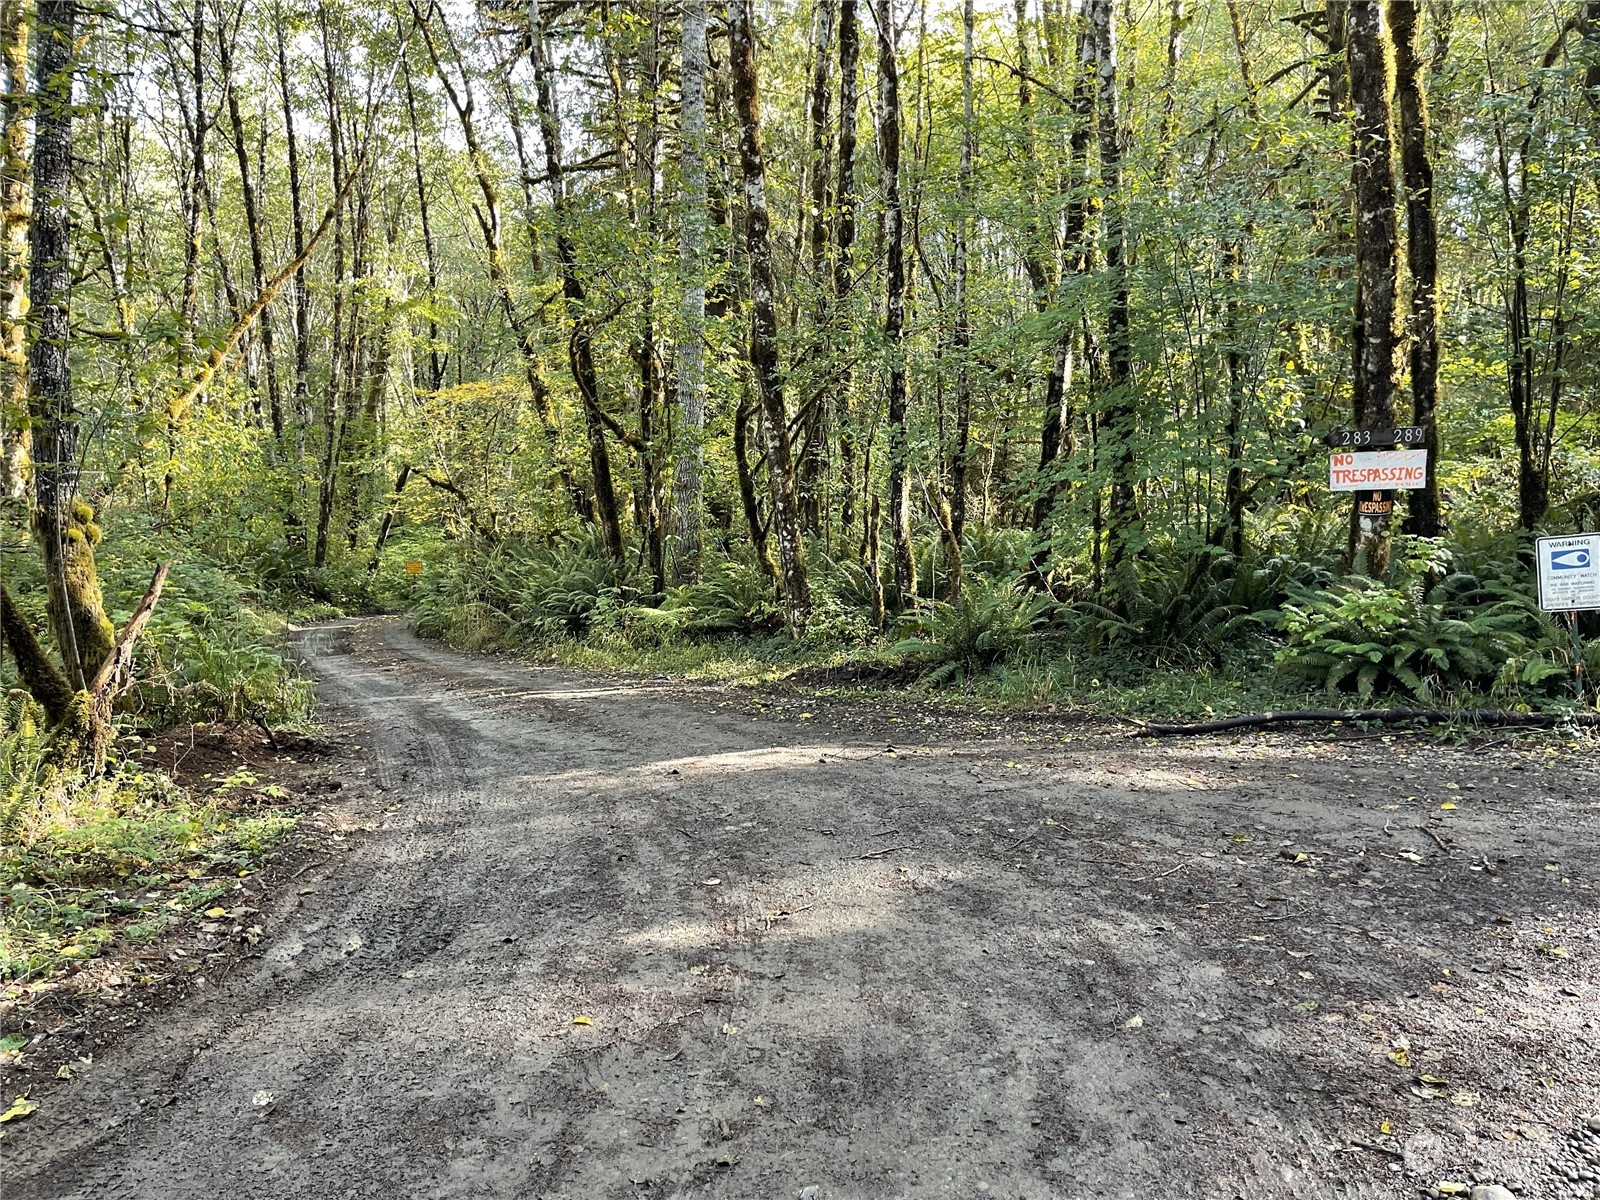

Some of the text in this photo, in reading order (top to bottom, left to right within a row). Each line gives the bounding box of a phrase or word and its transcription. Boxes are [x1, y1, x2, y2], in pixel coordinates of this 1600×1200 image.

[1342, 428, 1423, 445] 283 289
[1333, 454, 1354, 467] NO
[1332, 467, 1423, 484] TRESPASSING
[1372, 490, 1382, 502] NO
[1548, 538, 1591, 548] WARNING
